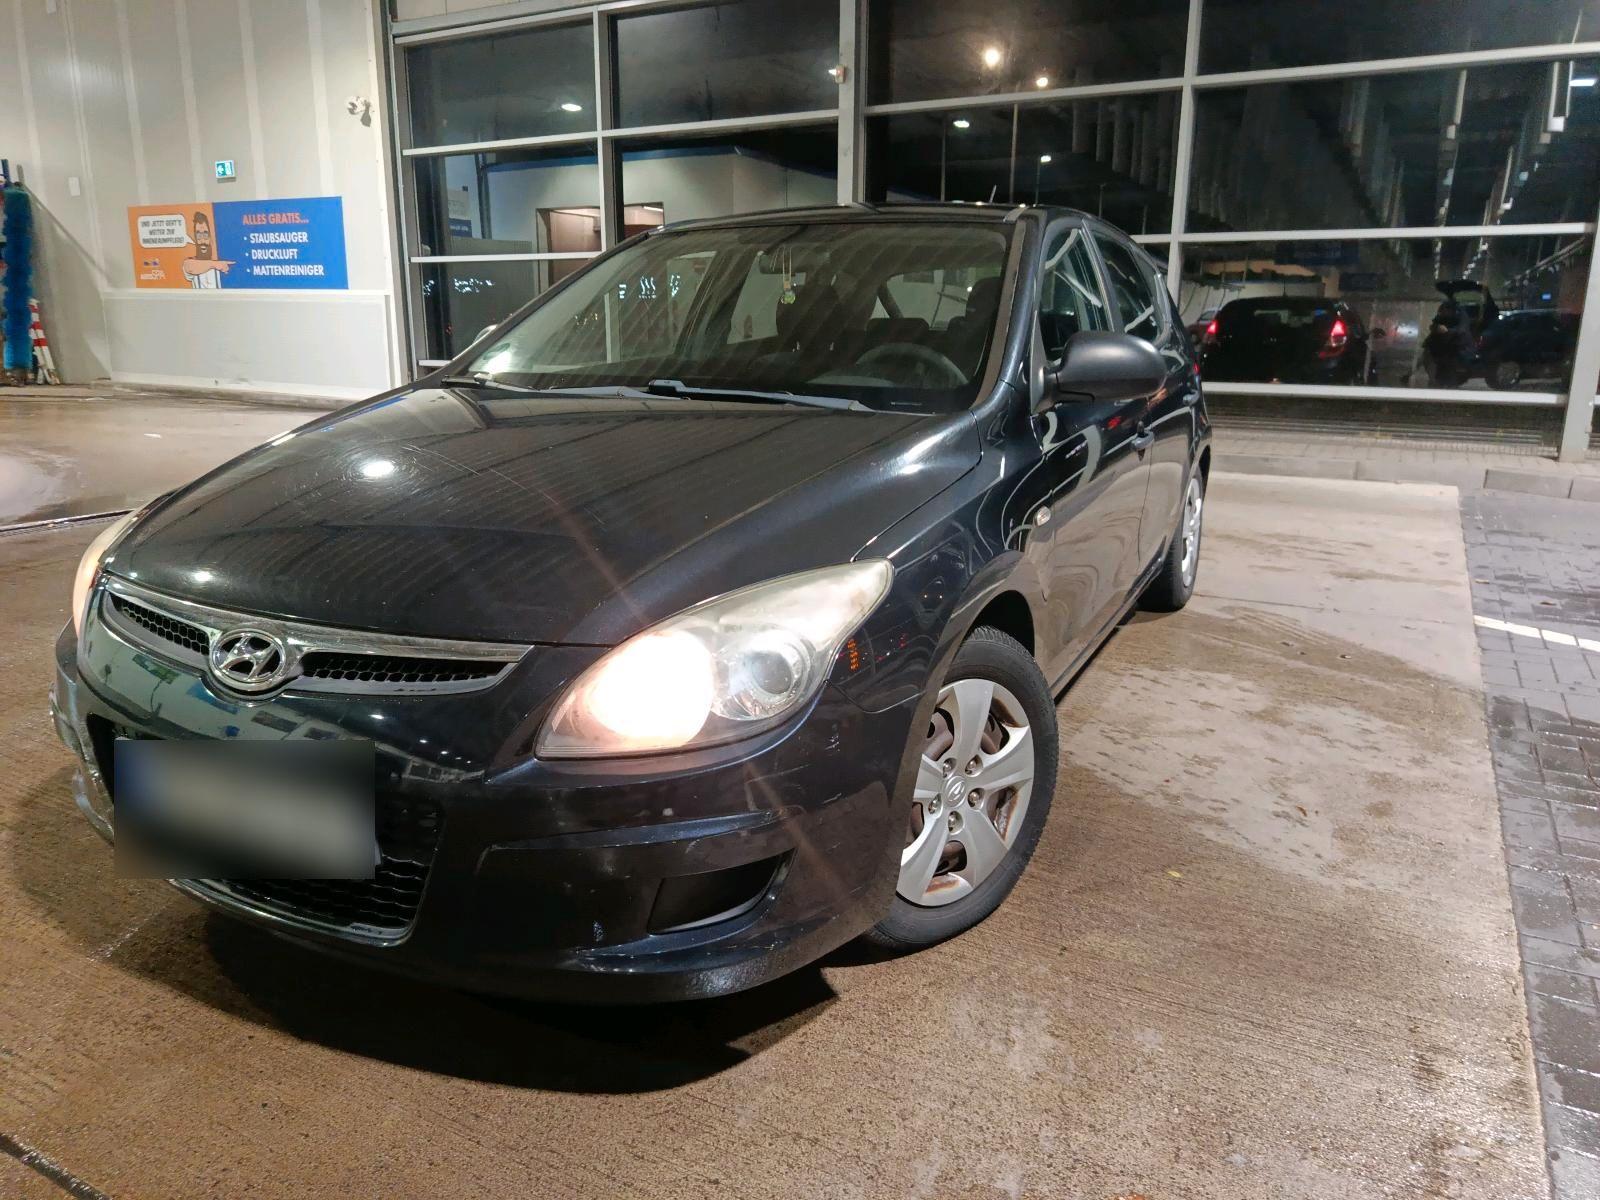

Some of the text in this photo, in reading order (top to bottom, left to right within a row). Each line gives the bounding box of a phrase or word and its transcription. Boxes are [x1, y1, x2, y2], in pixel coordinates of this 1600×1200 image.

[243, 212, 309, 225] ALLES GRATIS...
[249, 231, 309, 244] STAUBSAUGER
[251, 248, 298, 260] DRUCKLUFT
[253, 264, 325, 276] MATTENREINIGER
